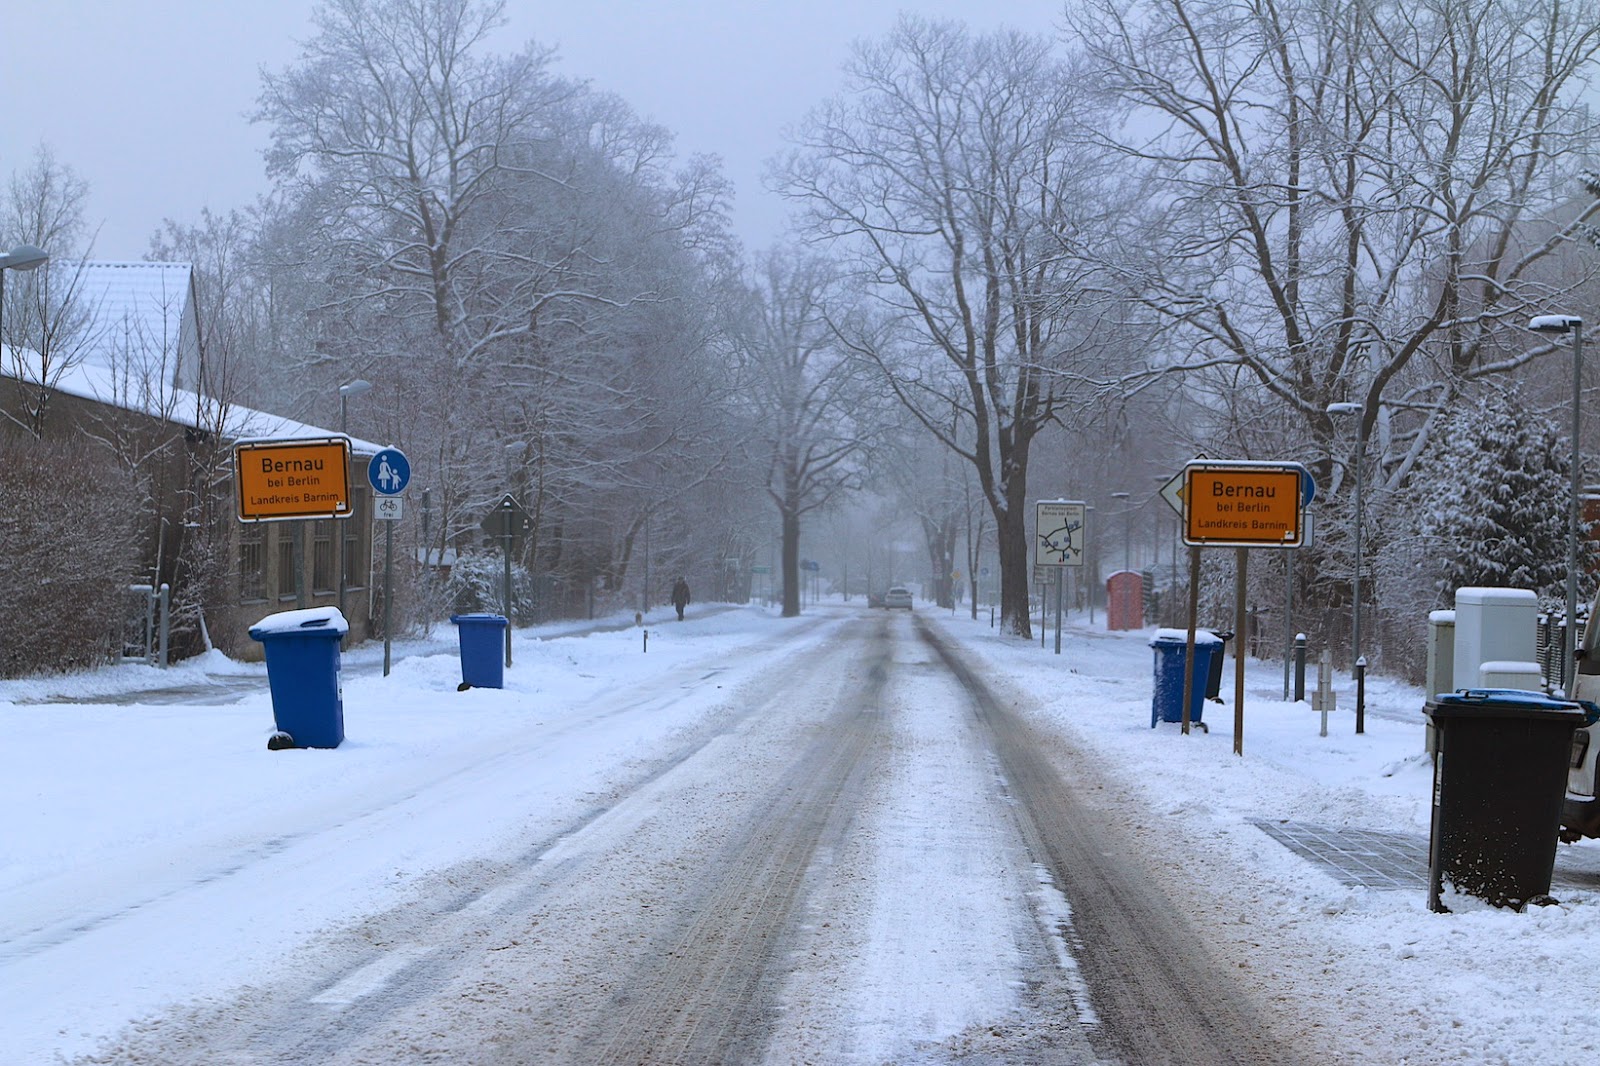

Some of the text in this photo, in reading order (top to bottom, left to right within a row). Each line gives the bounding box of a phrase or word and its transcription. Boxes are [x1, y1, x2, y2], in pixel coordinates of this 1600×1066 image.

[262, 458, 323, 473] Bernau
[267, 476, 320, 487] bei Berlin
[1213, 481, 1276, 498] Bernau
[251, 492, 338, 505] Landkreis Barnim
[1216, 502, 1270, 513] bei Berlin
[1198, 519, 1288, 530] Landkreis Barnim
